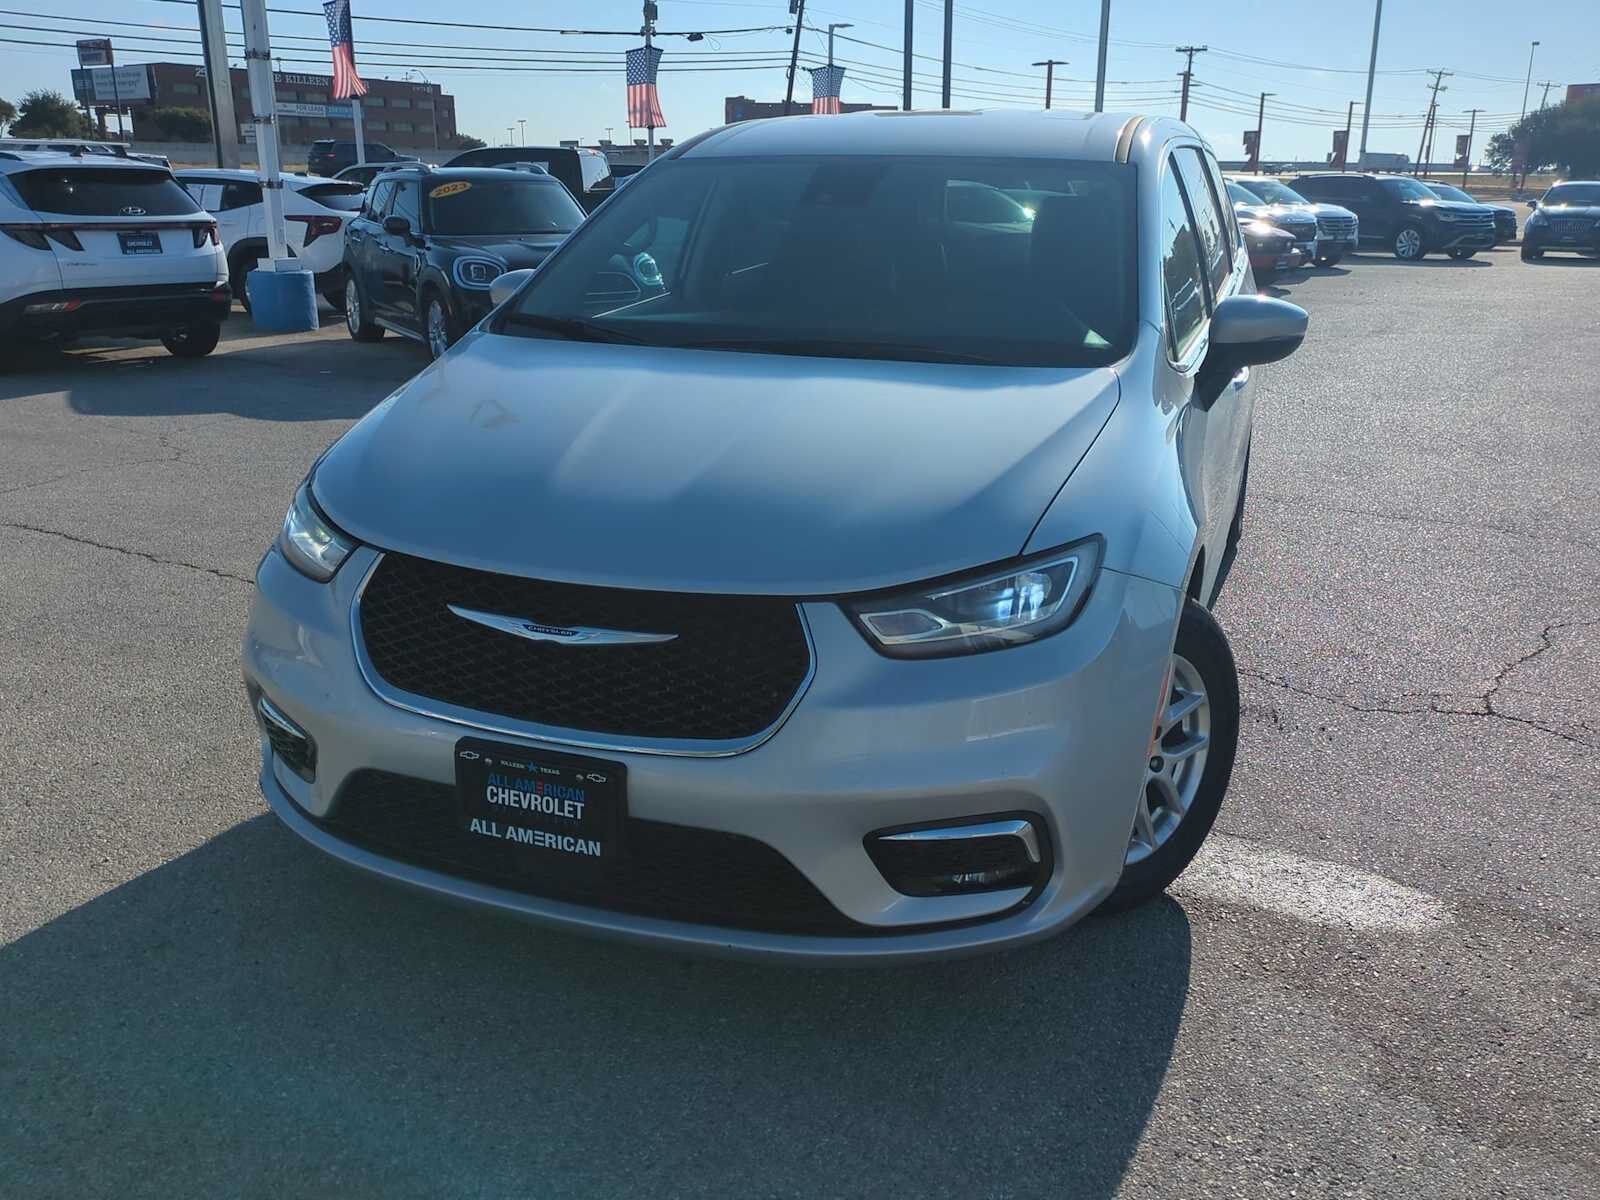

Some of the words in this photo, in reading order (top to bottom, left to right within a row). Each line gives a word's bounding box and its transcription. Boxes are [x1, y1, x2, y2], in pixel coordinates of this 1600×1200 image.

[286, 75, 329, 87] KILLEEN
[432, 183, 468, 195] 2023
[500, 760, 526, 770] KILLEEN
[540, 767, 561, 776] TEXAS
[487, 773, 510, 787] ALL
[514, 778, 585, 802] AMERICAN
[486, 785, 585, 820] CHEVROLET
[469, 818, 502, 838] ALL
[505, 825, 601, 857] AMERICAN
